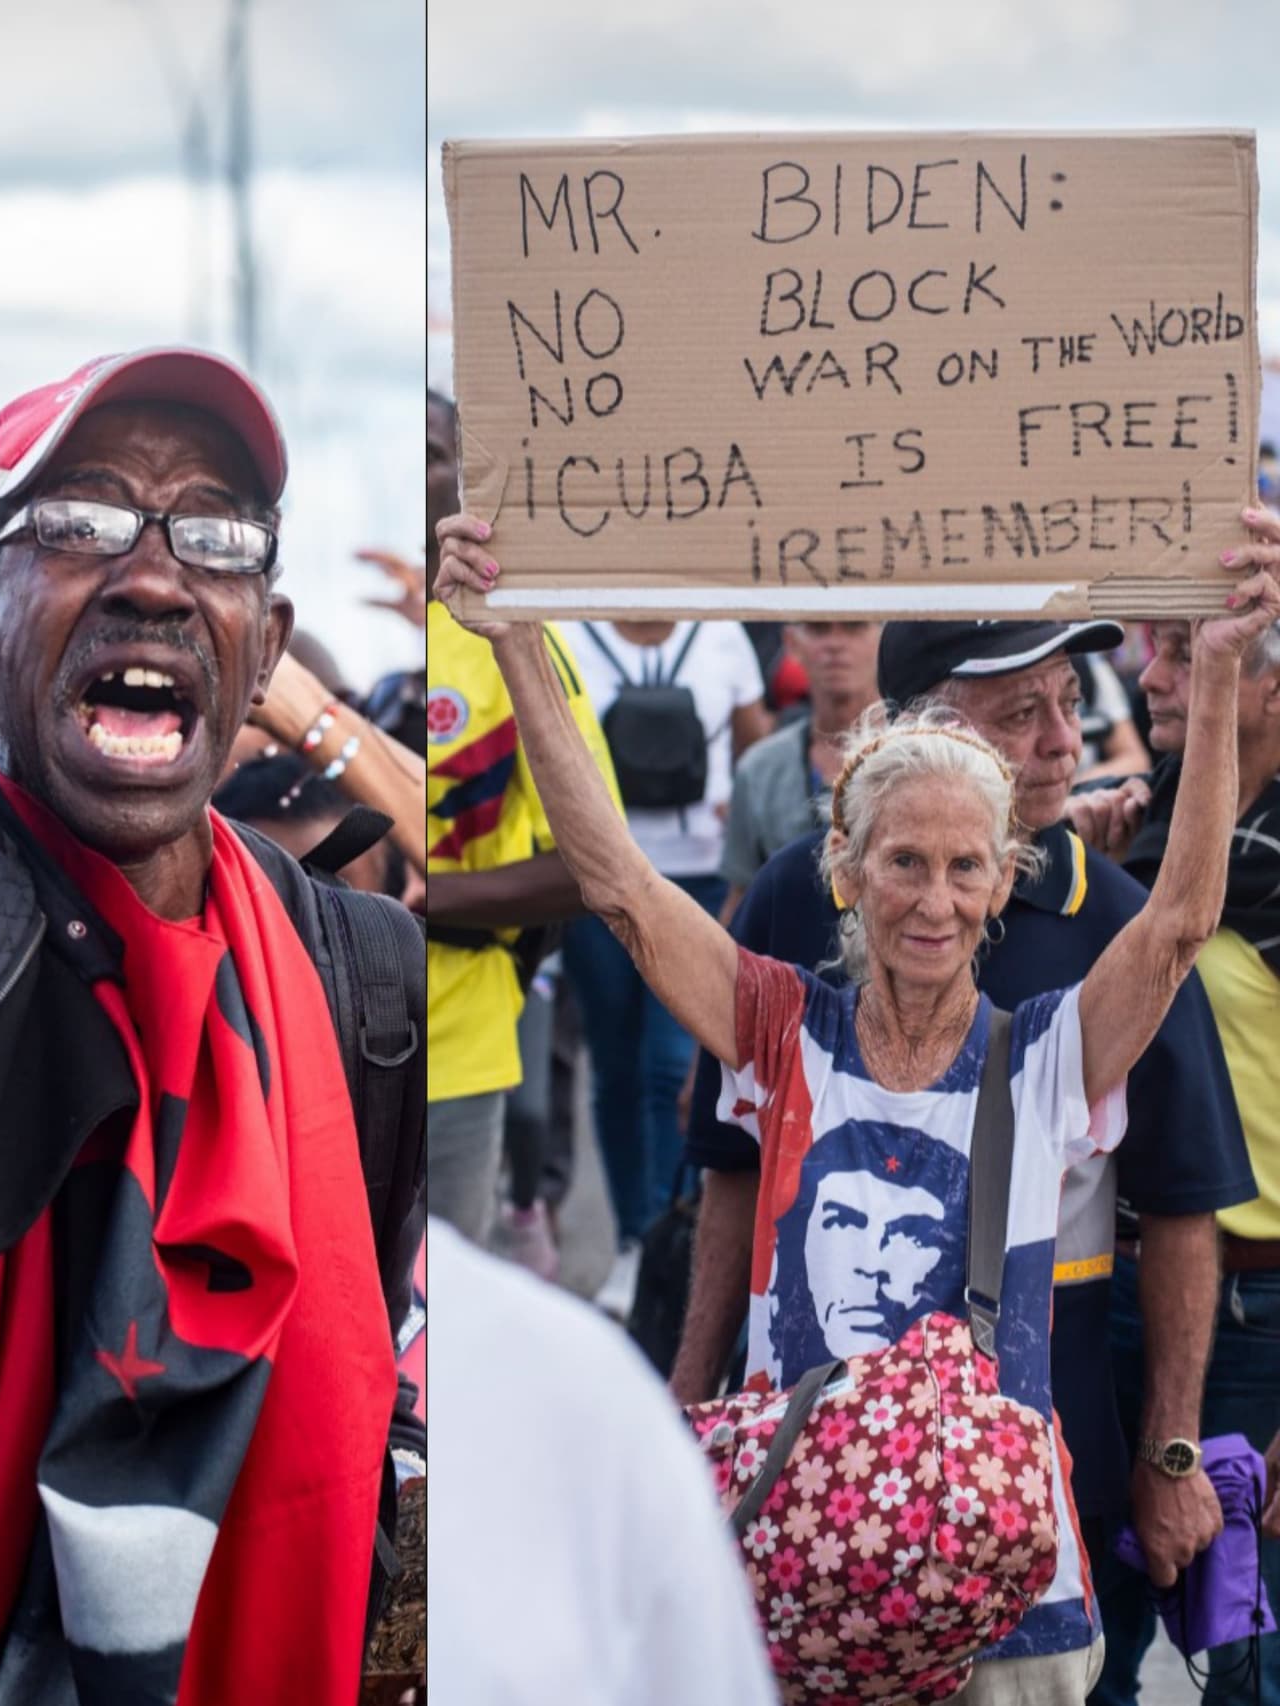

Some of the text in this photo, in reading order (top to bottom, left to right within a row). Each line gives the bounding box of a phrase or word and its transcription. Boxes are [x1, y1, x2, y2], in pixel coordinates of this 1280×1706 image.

[519, 153, 1067, 258] MR. BIDEN:
[507, 261, 1006, 379] NO BLOCK
[528, 371, 624, 427] NO
[744, 341, 903, 399] WAR
[936, 347, 999, 387] ON
[1021, 333, 1097, 373] THE
[840, 429, 926, 489] IS
[1018, 372, 1238, 467] FREE!
